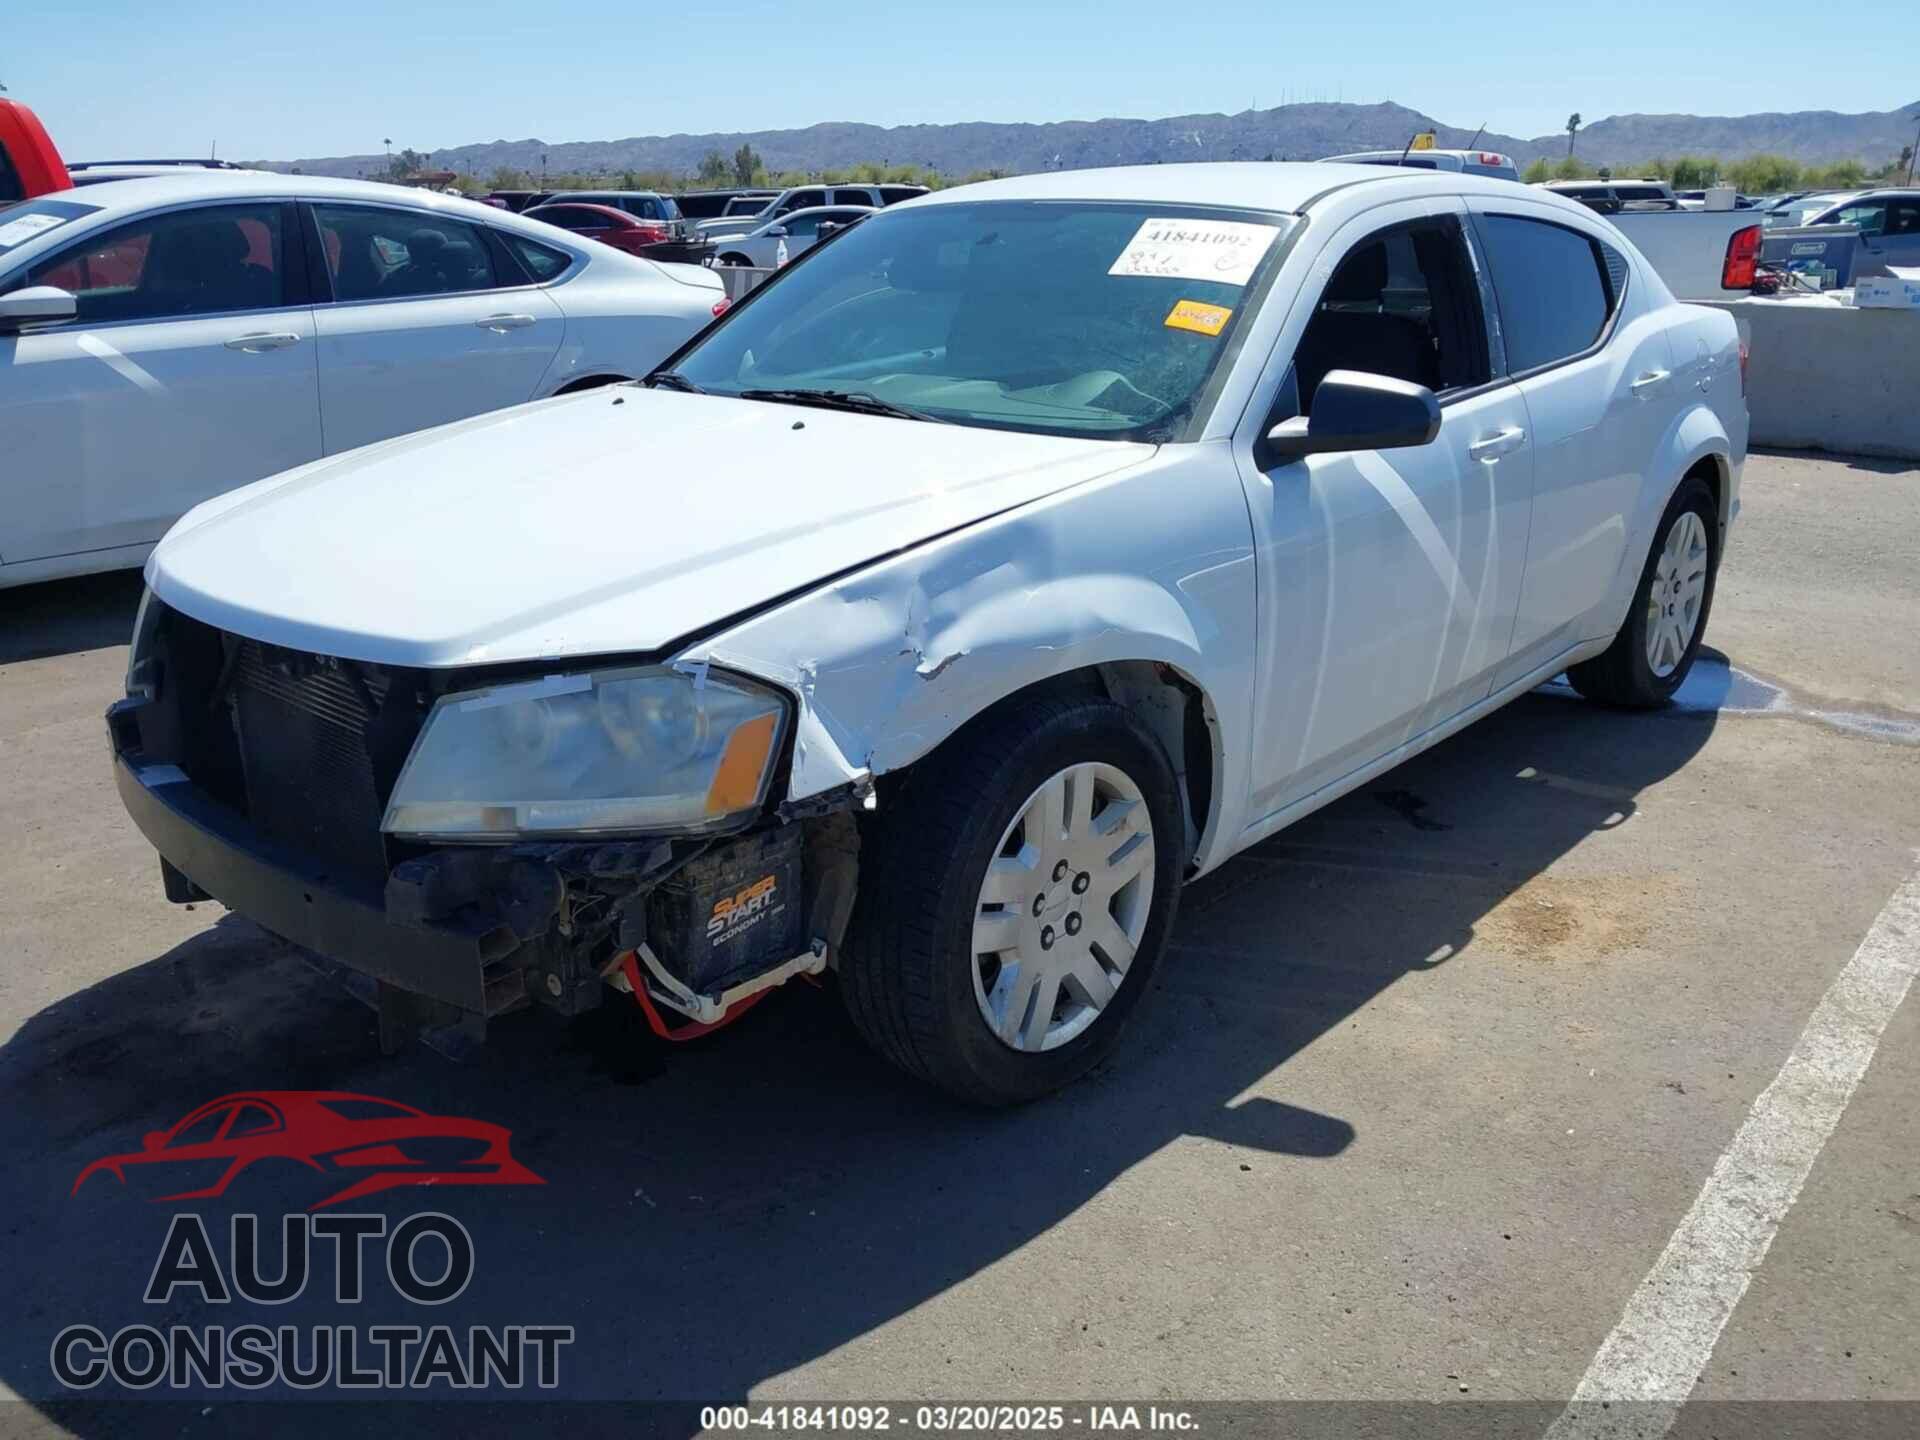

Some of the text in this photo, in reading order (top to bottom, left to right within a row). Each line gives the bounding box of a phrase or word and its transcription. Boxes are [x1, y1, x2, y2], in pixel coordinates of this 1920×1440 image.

[1147, 229, 1252, 247] 41841092
[706, 886, 776, 938] START
[713, 911, 767, 946] ECONOMY
